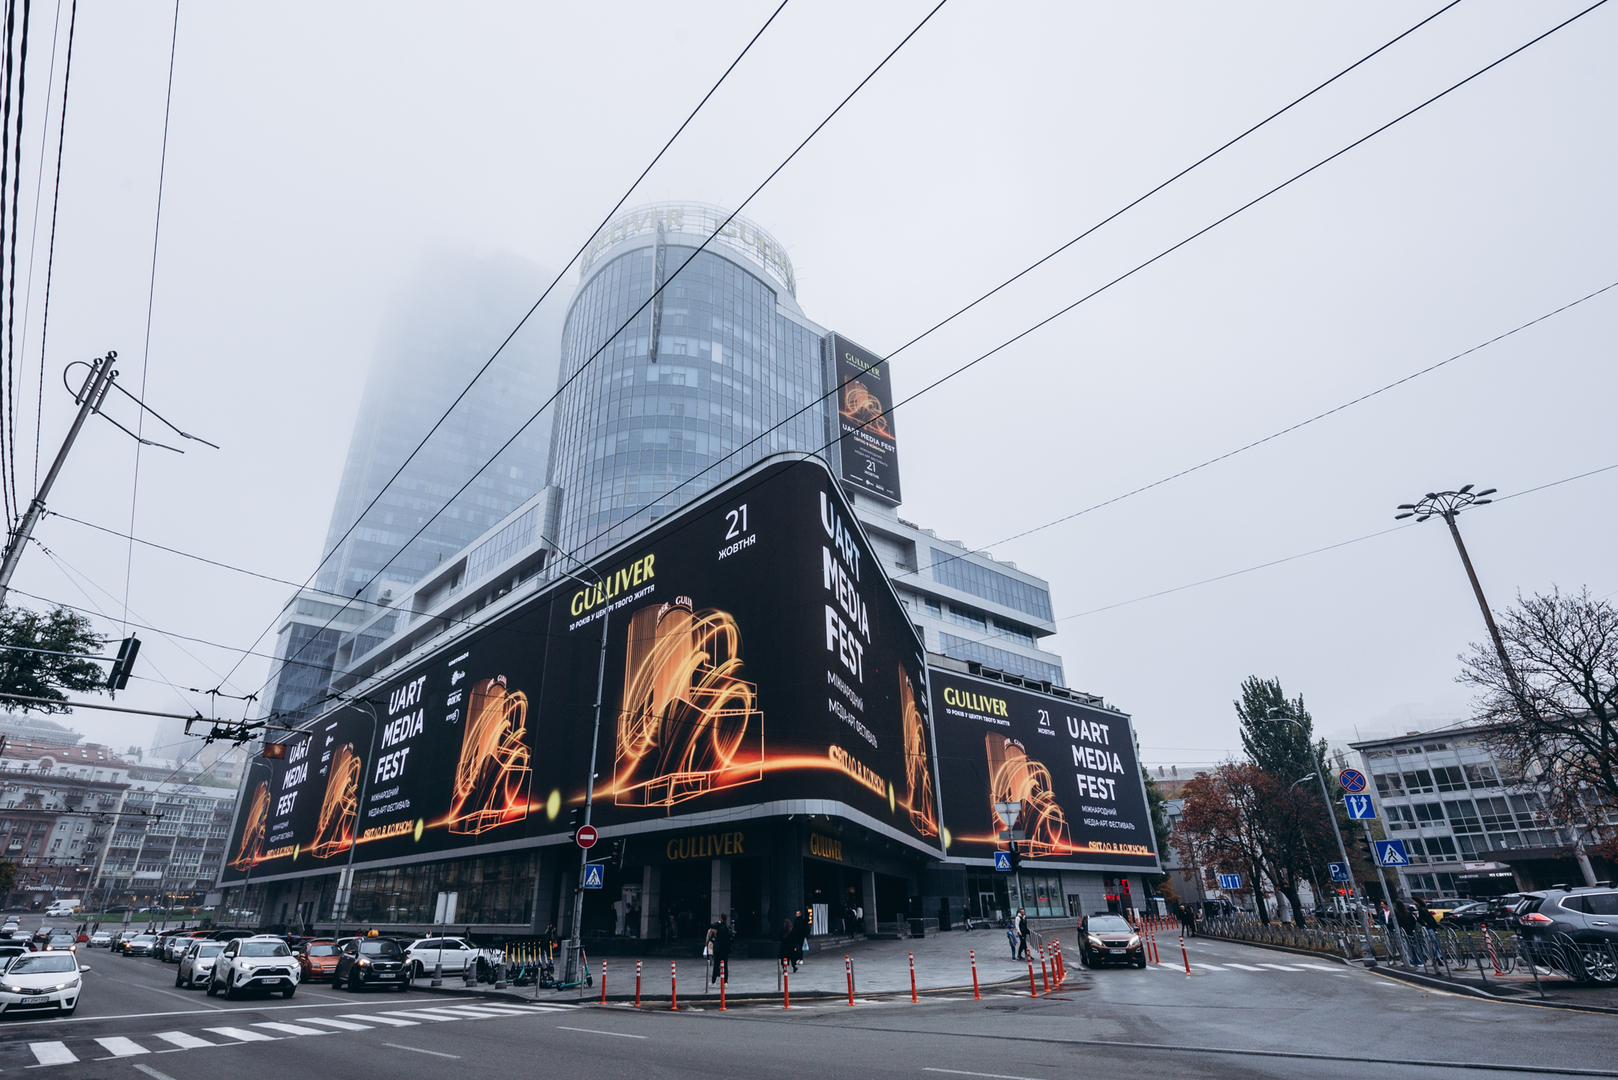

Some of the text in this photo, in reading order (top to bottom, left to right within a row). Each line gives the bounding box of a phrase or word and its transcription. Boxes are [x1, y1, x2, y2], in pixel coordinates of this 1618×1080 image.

[846, 353, 880, 376] GULLIVER
[842, 424, 895, 452] UART MEDIA FEST
[866, 460, 876, 472] 21
[725, 503, 747, 540] 21
[718, 534, 756, 560] ЖОВТНЯ
[820, 491, 860, 582] UART
[570, 553, 655, 616] GULLIVER
[822, 546, 871, 644] MEDIA
[575, 616, 590, 629] РОКІВ
[615, 595, 633, 609] ТВОГО
[634, 584, 655, 601] ЖИТТЯ
[825, 604, 863, 683] FEST
[389, 675, 426, 715] UART
[944, 687, 1008, 717] GULLIVER
[381, 708, 424, 749] MEDIA
[952, 710, 964, 718] РОКІВ
[997, 718, 1010, 726] ЖИТТЯ
[1037, 727, 1055, 736] ЖОВТНЯ
[1038, 709, 1050, 726] 21
[1066, 716, 1109, 745] UART
[289, 736, 312, 764] UART
[1072, 744, 1124, 774] MEDIA
[282, 761, 308, 790] MEDIA
[374, 747, 410, 784] FEST
[1077, 774, 1115, 801] FEST
[276, 791, 298, 817] FEST
[1081, 805, 1117, 816] МІЖНАРОДНИЙ
[1108, 821, 1135, 830] ФЕСТИВАЛЬ
[667, 831, 745, 860] GULLIVER
[809, 832, 842, 861] GULLIVER
[1330, 864, 1339, 877] P
